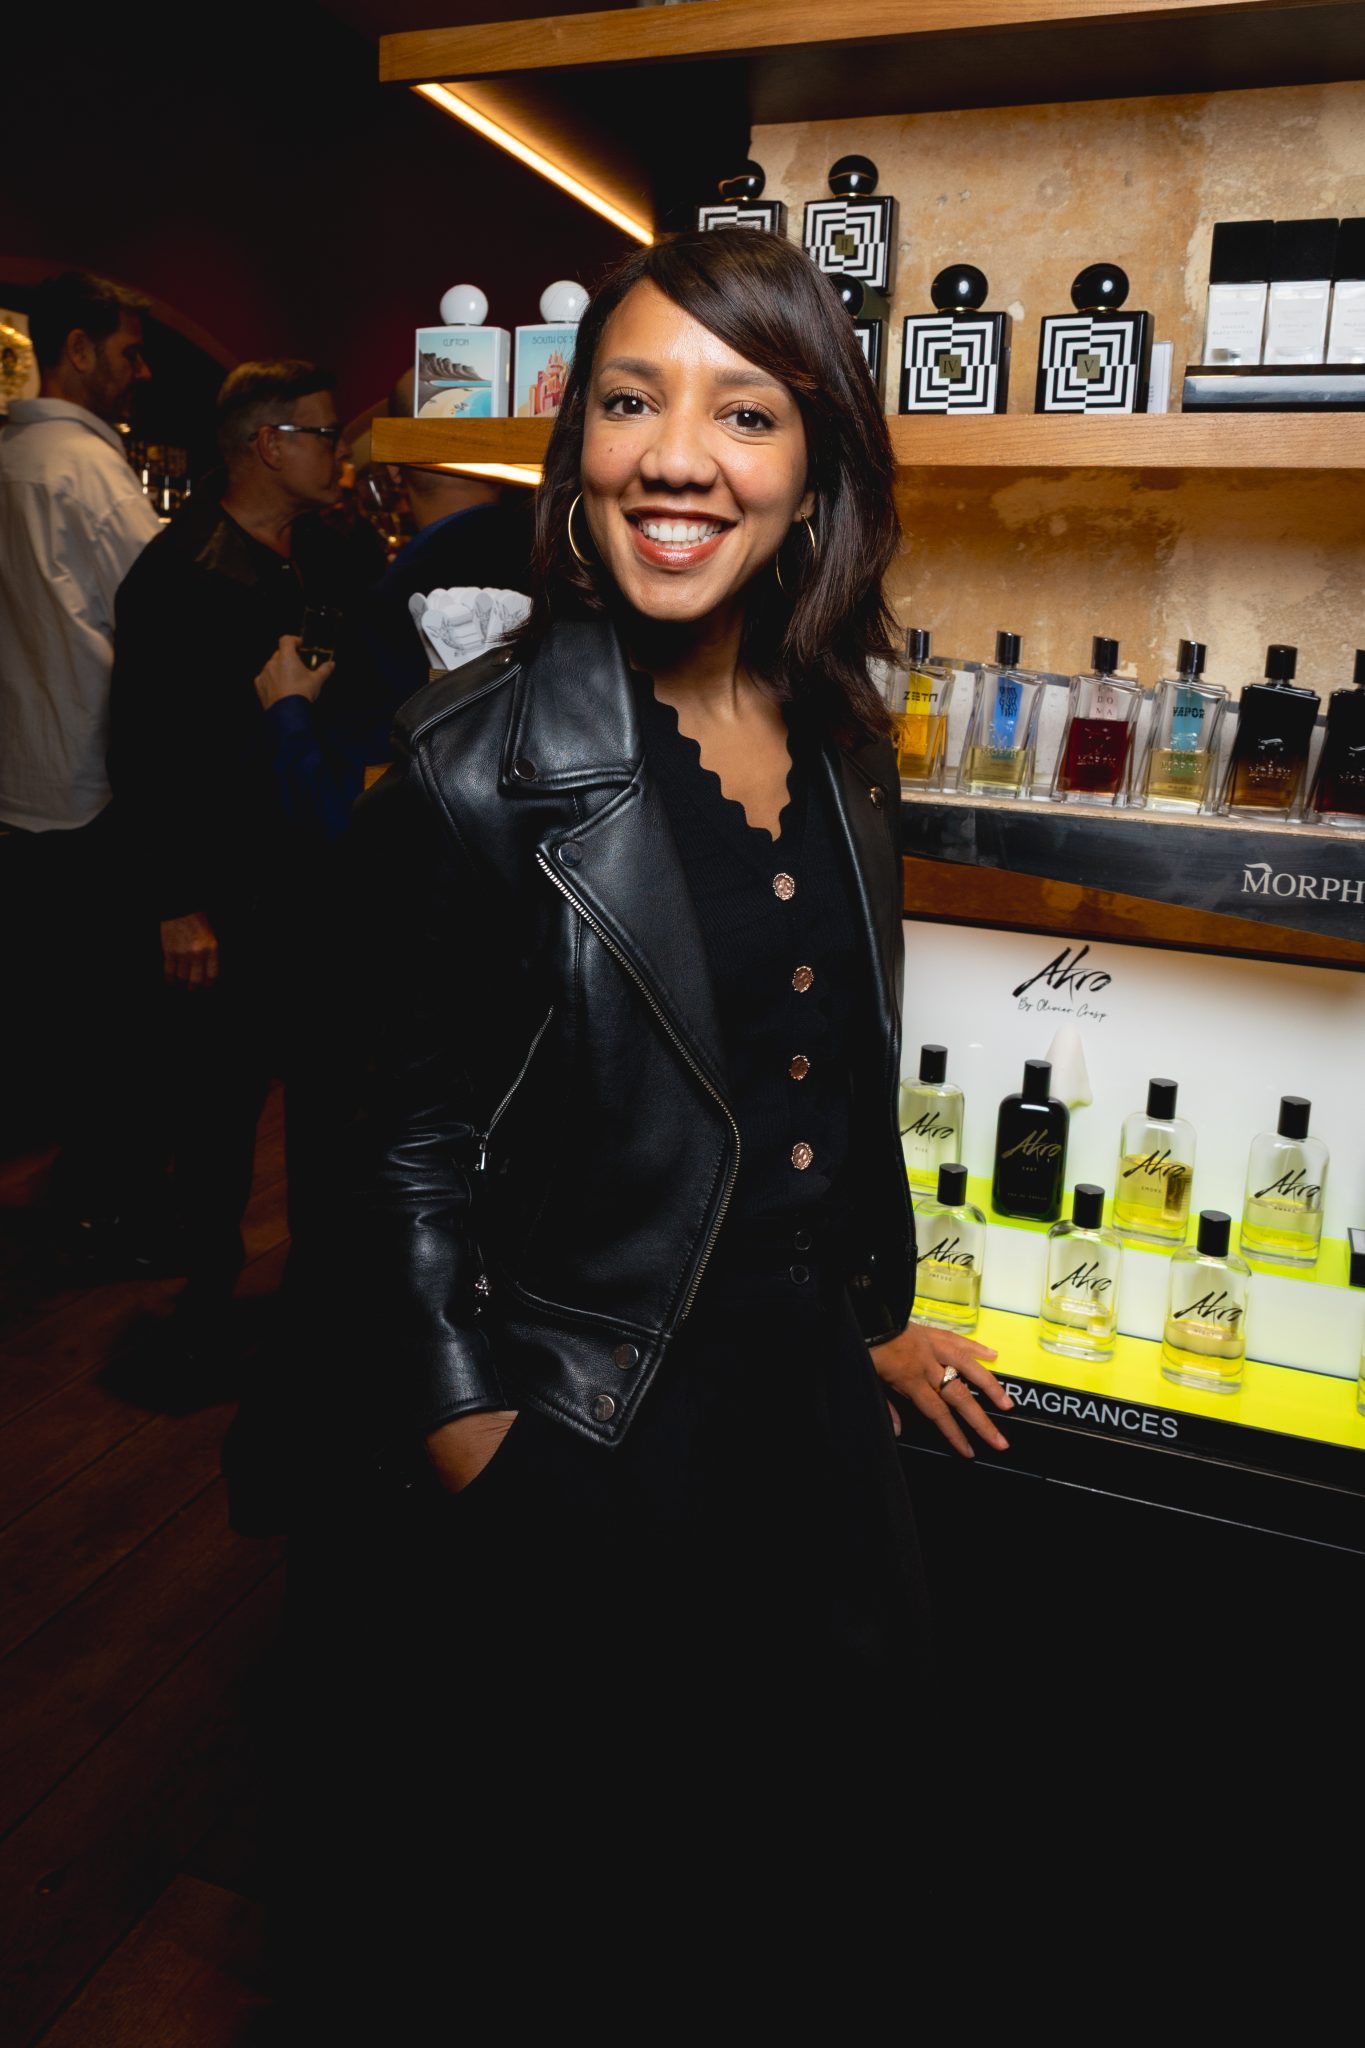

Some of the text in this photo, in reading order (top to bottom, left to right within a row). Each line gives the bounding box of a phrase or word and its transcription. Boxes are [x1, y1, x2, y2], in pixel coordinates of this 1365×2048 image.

[943, 359, 956, 374] IV
[1084, 359, 1095, 374] V
[1172, 706, 1205, 719] VAPOR
[1241, 863, 1365, 904] MORPH
[1012, 944, 1112, 1003] Akro
[1018, 997, 1034, 1012] By
[901, 1111, 954, 1143] Akro
[1001, 1129, 1062, 1162] Akro
[1122, 1149, 1186, 1184] Akro
[1254, 1168, 1321, 1200] Akro
[917, 1237, 975, 1270] Akro
[1050, 1261, 1113, 1295] Akro
[1173, 1291, 1244, 1328] Akro
[998, 1381, 1179, 1439] RAGRANCES
